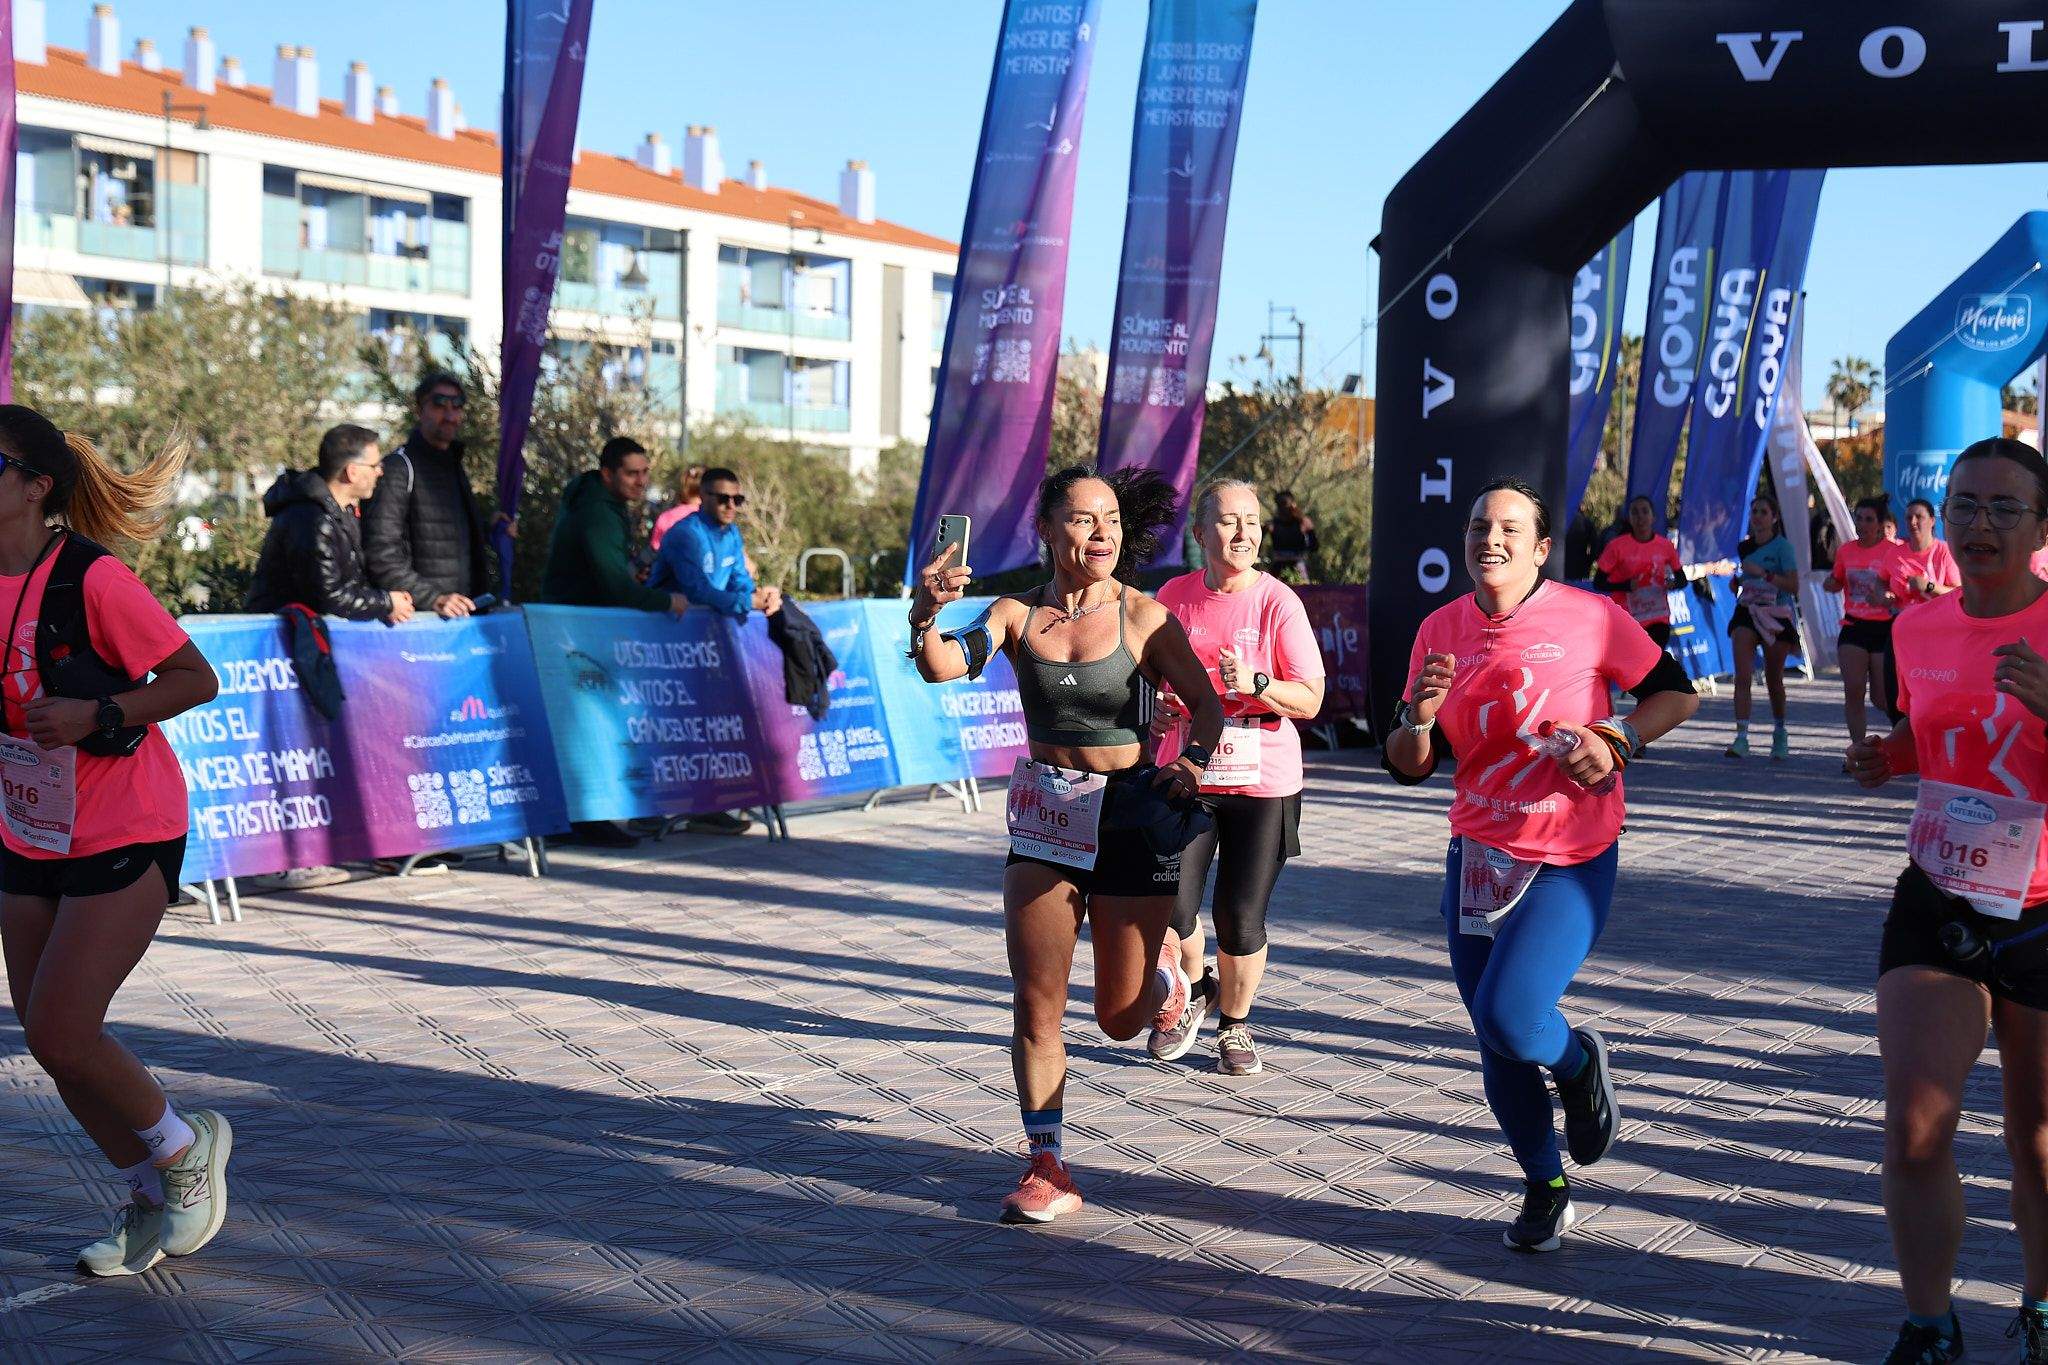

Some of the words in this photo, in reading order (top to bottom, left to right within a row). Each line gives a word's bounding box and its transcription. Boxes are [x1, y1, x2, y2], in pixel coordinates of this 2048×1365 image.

[1716, 20, 2048, 82] VOL
[1653, 246, 1699, 408] GOYA
[1704, 267, 1757, 419] GOYA
[1417, 273, 1458, 594] OLVO
[1900, 463, 1949, 498] Marle
[1455, 653, 1486, 669] YSHO
[1525, 650, 1562, 661] ASTURIANA
[1910, 667, 1958, 683] OYSHO
[166, 708, 228, 745] NTOS
[225, 706, 261, 741] EL
[1215, 742, 1235, 756] 16
[242, 750, 274, 786] DE
[270, 746, 336, 784] MAMA
[3, 777, 40, 805] 016
[193, 789, 333, 841] METASTÁSICO
[1039, 806, 1070, 828] 016
[1519, 800, 1558, 814] MUJER
[1949, 803, 1993, 820] ASTURIANA
[1939, 840, 1989, 868] 016
[1471, 919, 1492, 931] OYS
